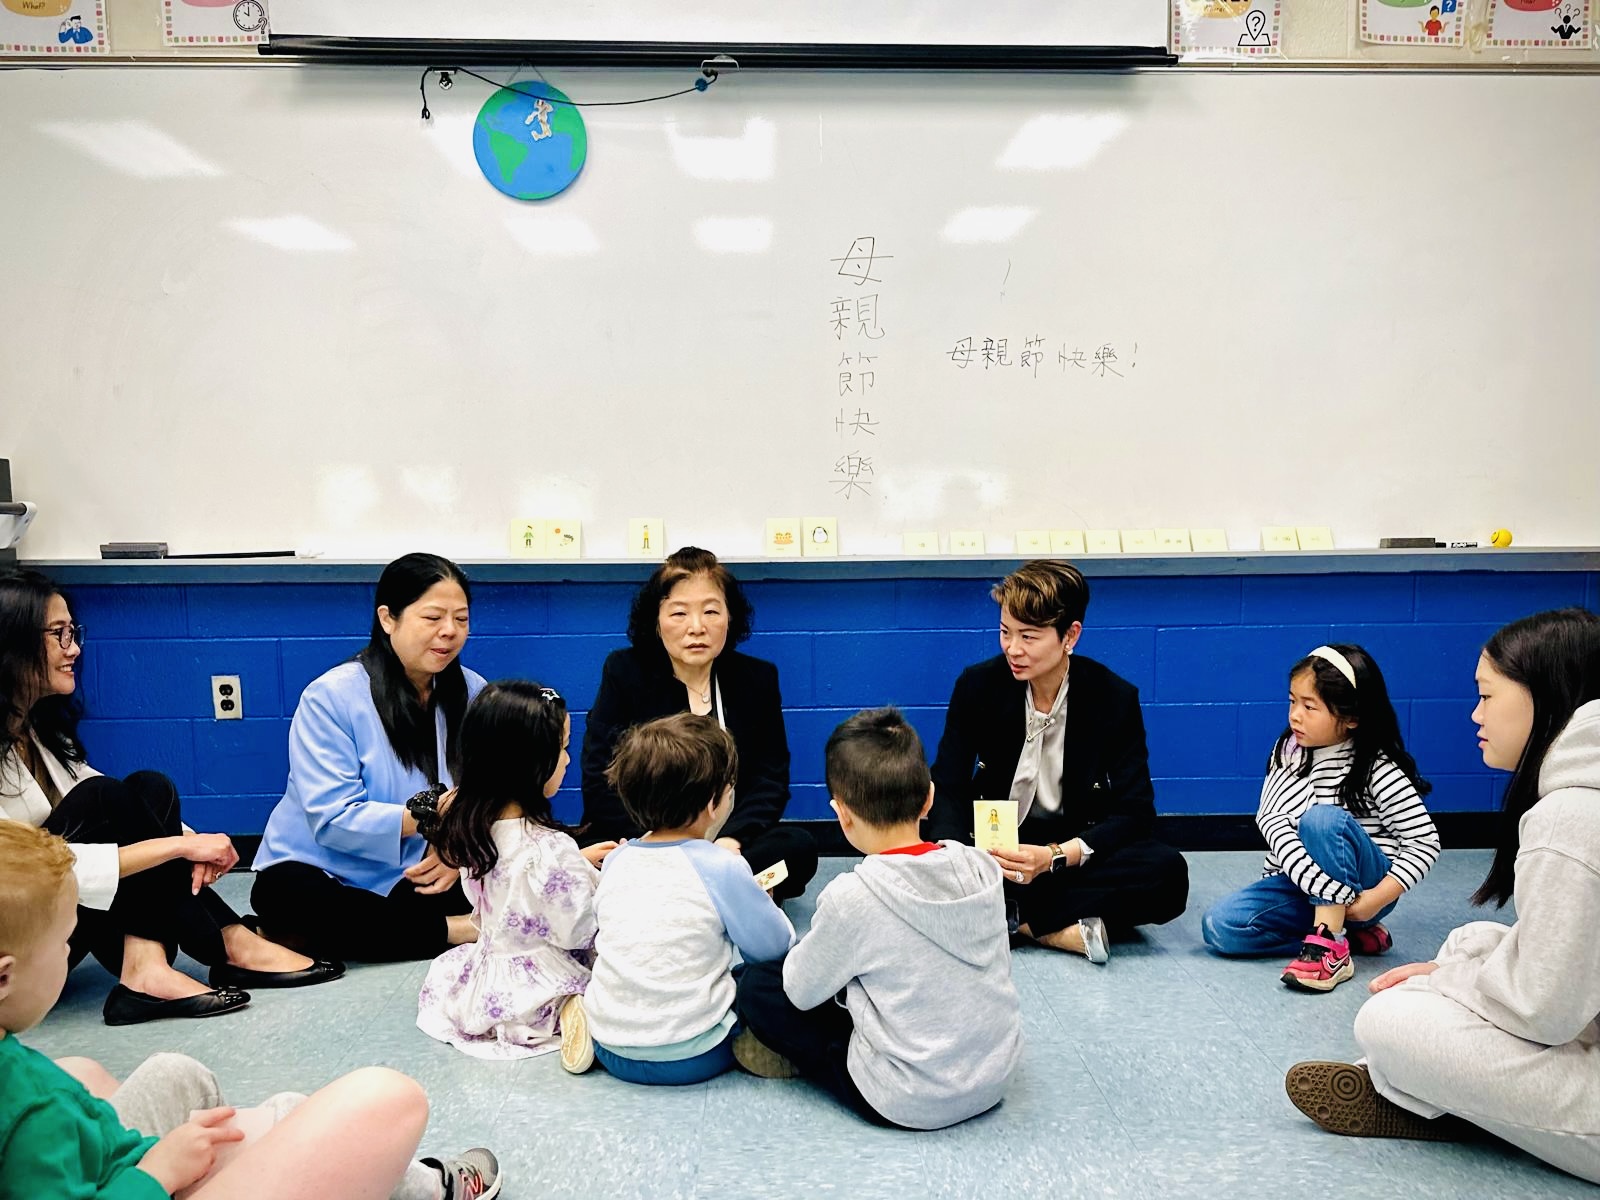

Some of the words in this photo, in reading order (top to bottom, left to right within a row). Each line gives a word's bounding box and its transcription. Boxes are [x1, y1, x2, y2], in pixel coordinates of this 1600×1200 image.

[829, 236, 894, 500] 母親節快樂
